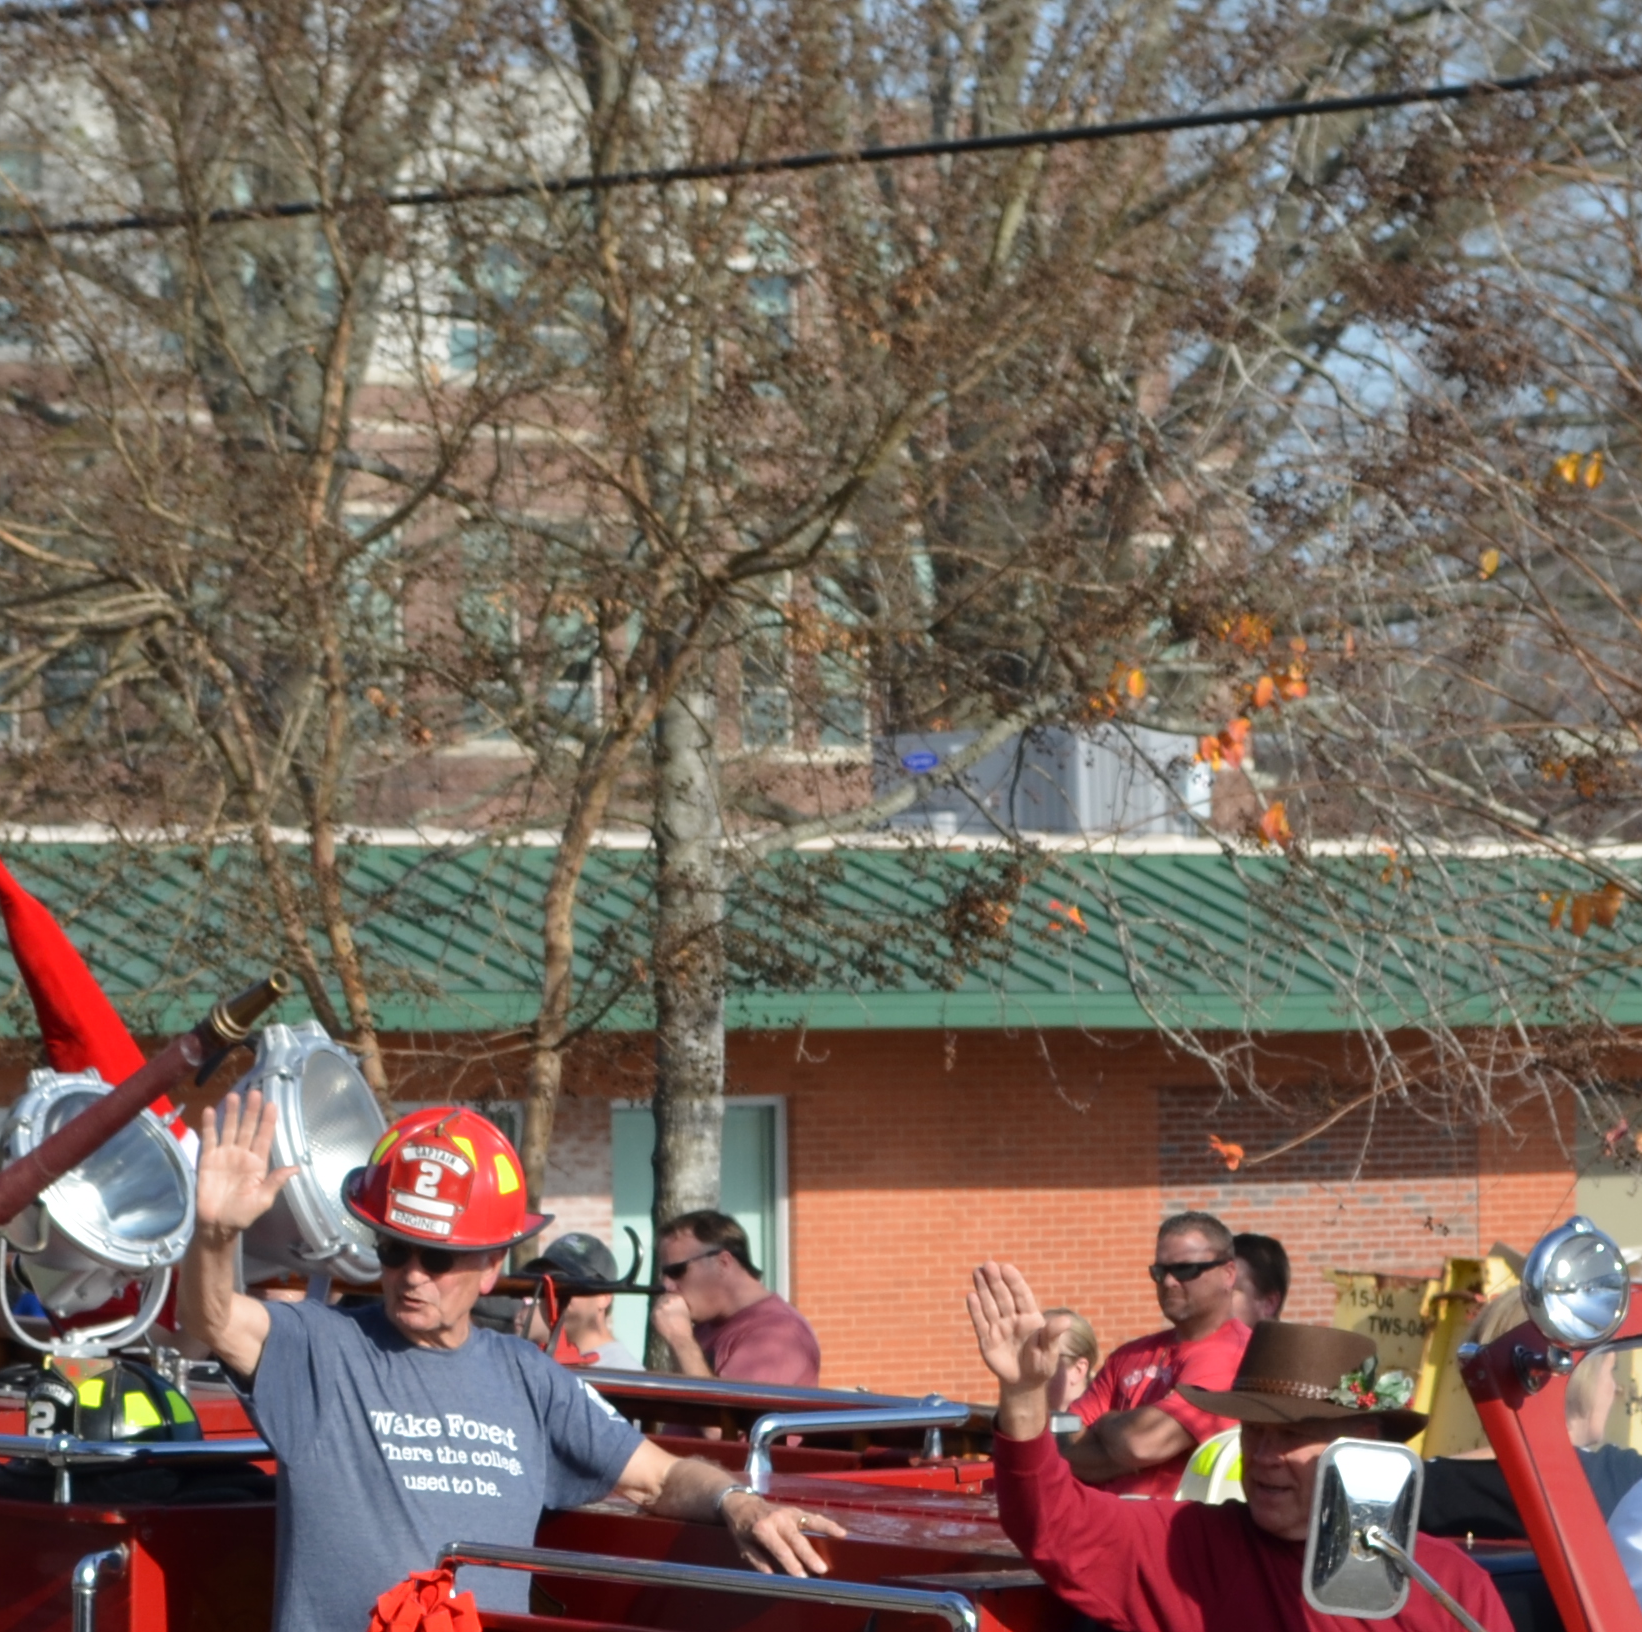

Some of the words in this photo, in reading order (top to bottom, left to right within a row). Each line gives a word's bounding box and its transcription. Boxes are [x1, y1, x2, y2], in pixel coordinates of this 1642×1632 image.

[415, 1146, 458, 1166] CAPTAIN
[414, 1160, 443, 1198] 2
[393, 1210, 436, 1231] ENGINE
[1368, 1315, 1427, 1338] TWS-04
[28, 1401, 56, 1439] 2
[370, 1410, 442, 1437] Wake
[436, 1445, 468, 1464] the
[403, 1474, 451, 1492] used
[451, 1476, 474, 1494] to
[475, 1476, 502, 1498] be.
